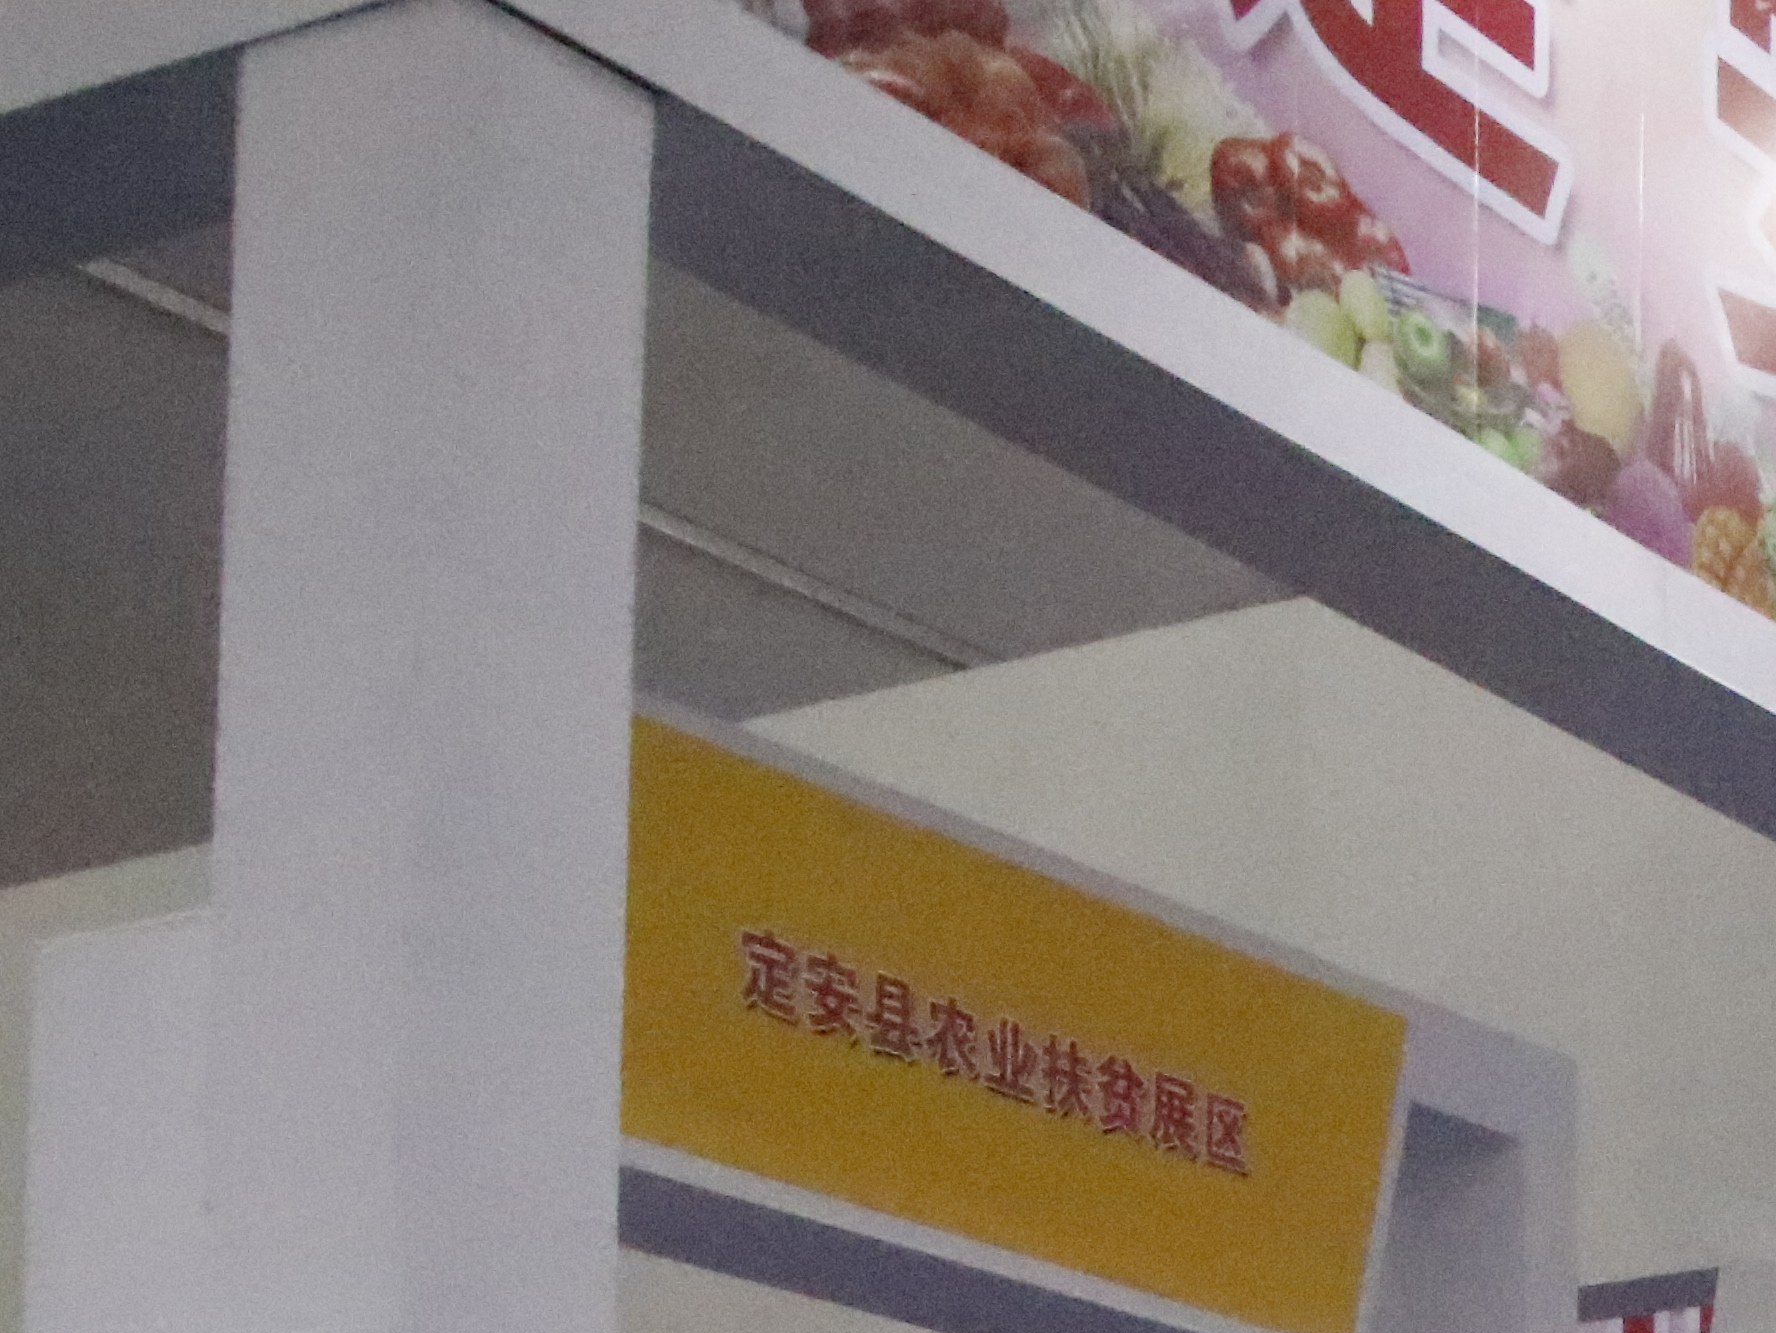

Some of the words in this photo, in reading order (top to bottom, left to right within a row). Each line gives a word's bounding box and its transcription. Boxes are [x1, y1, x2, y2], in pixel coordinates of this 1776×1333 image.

[740, 929, 1251, 1176] 定安县农业扶贫展区
